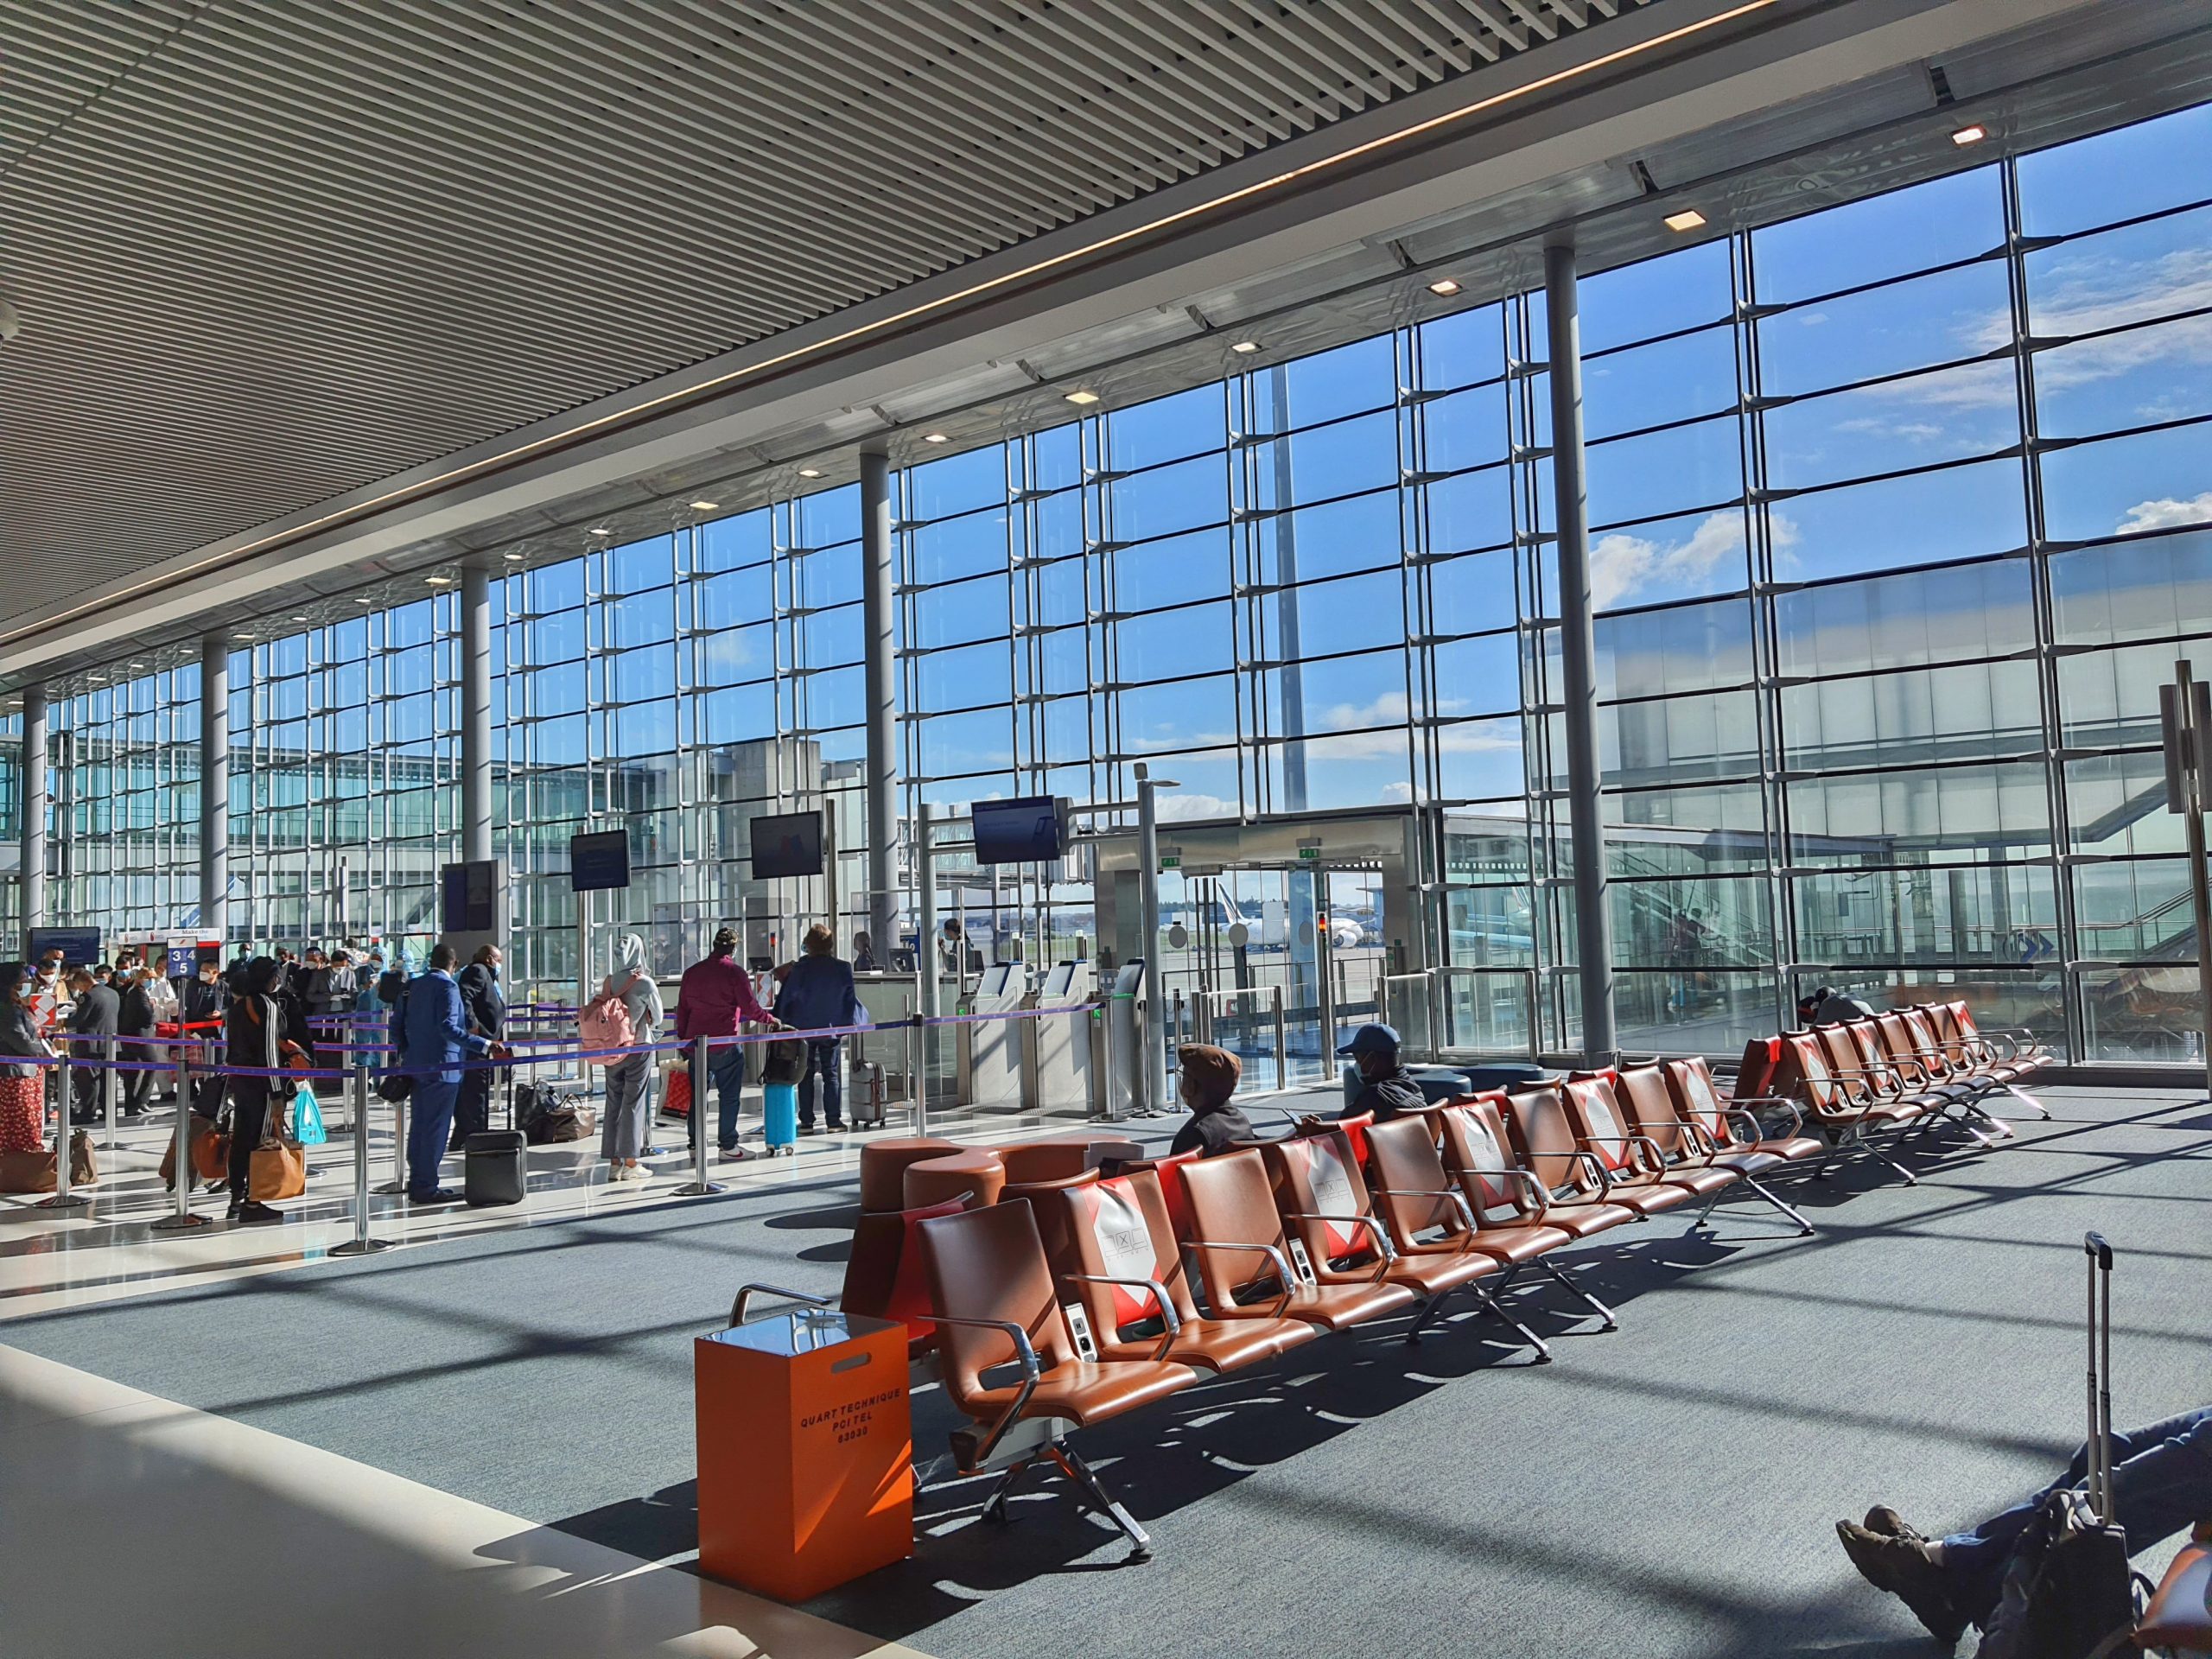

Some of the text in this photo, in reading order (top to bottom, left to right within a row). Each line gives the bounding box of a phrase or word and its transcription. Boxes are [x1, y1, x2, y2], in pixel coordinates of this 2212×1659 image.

[172, 950, 196, 962] 3 4
[179, 962, 188, 974] 5
[800, 1388, 901, 1428] QUART TECHNIQUE
[832, 1411, 873, 1433] PCI TEL
